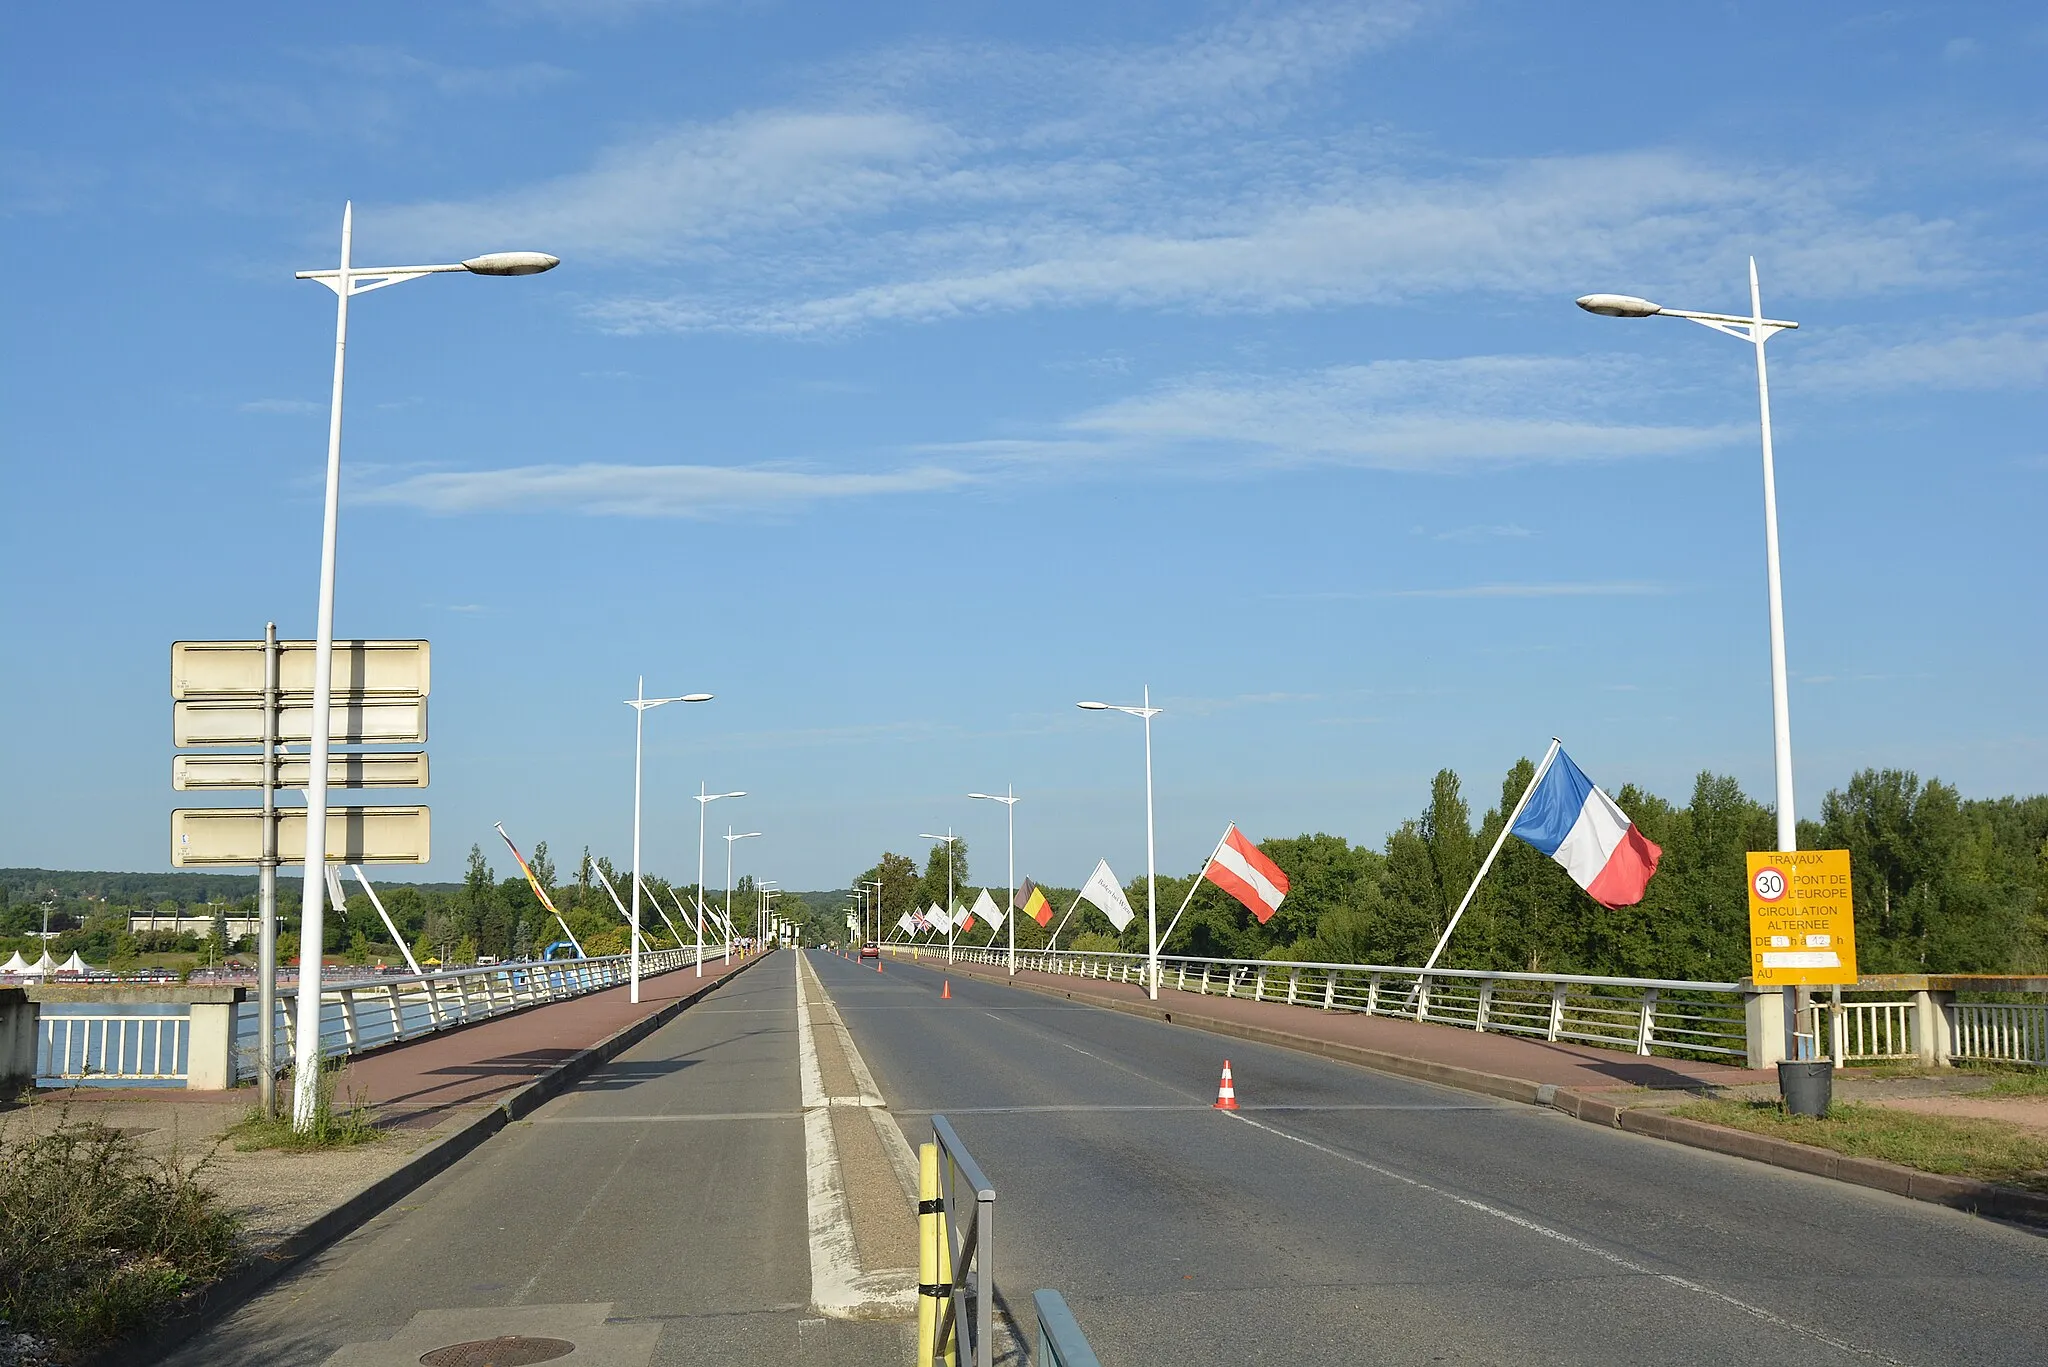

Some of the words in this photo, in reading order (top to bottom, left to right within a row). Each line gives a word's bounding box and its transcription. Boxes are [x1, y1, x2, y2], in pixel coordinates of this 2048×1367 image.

[1768, 855, 1824, 865] TRAVAUX
[1758, 875, 1782, 894] 30
[1793, 875, 1827, 885] PONT
[1830, 875, 1847, 885] DE
[1788, 888, 1848, 899] L'EUROPE
[1758, 906, 1838, 917] CIRCULATION
[1768, 920, 1829, 930] ALTERNEE
[1755, 937, 1771, 946] DE
[1790, 936, 1797, 946] h
[1837, 935, 1844, 945] h
[1757, 969, 1773, 979] AU
